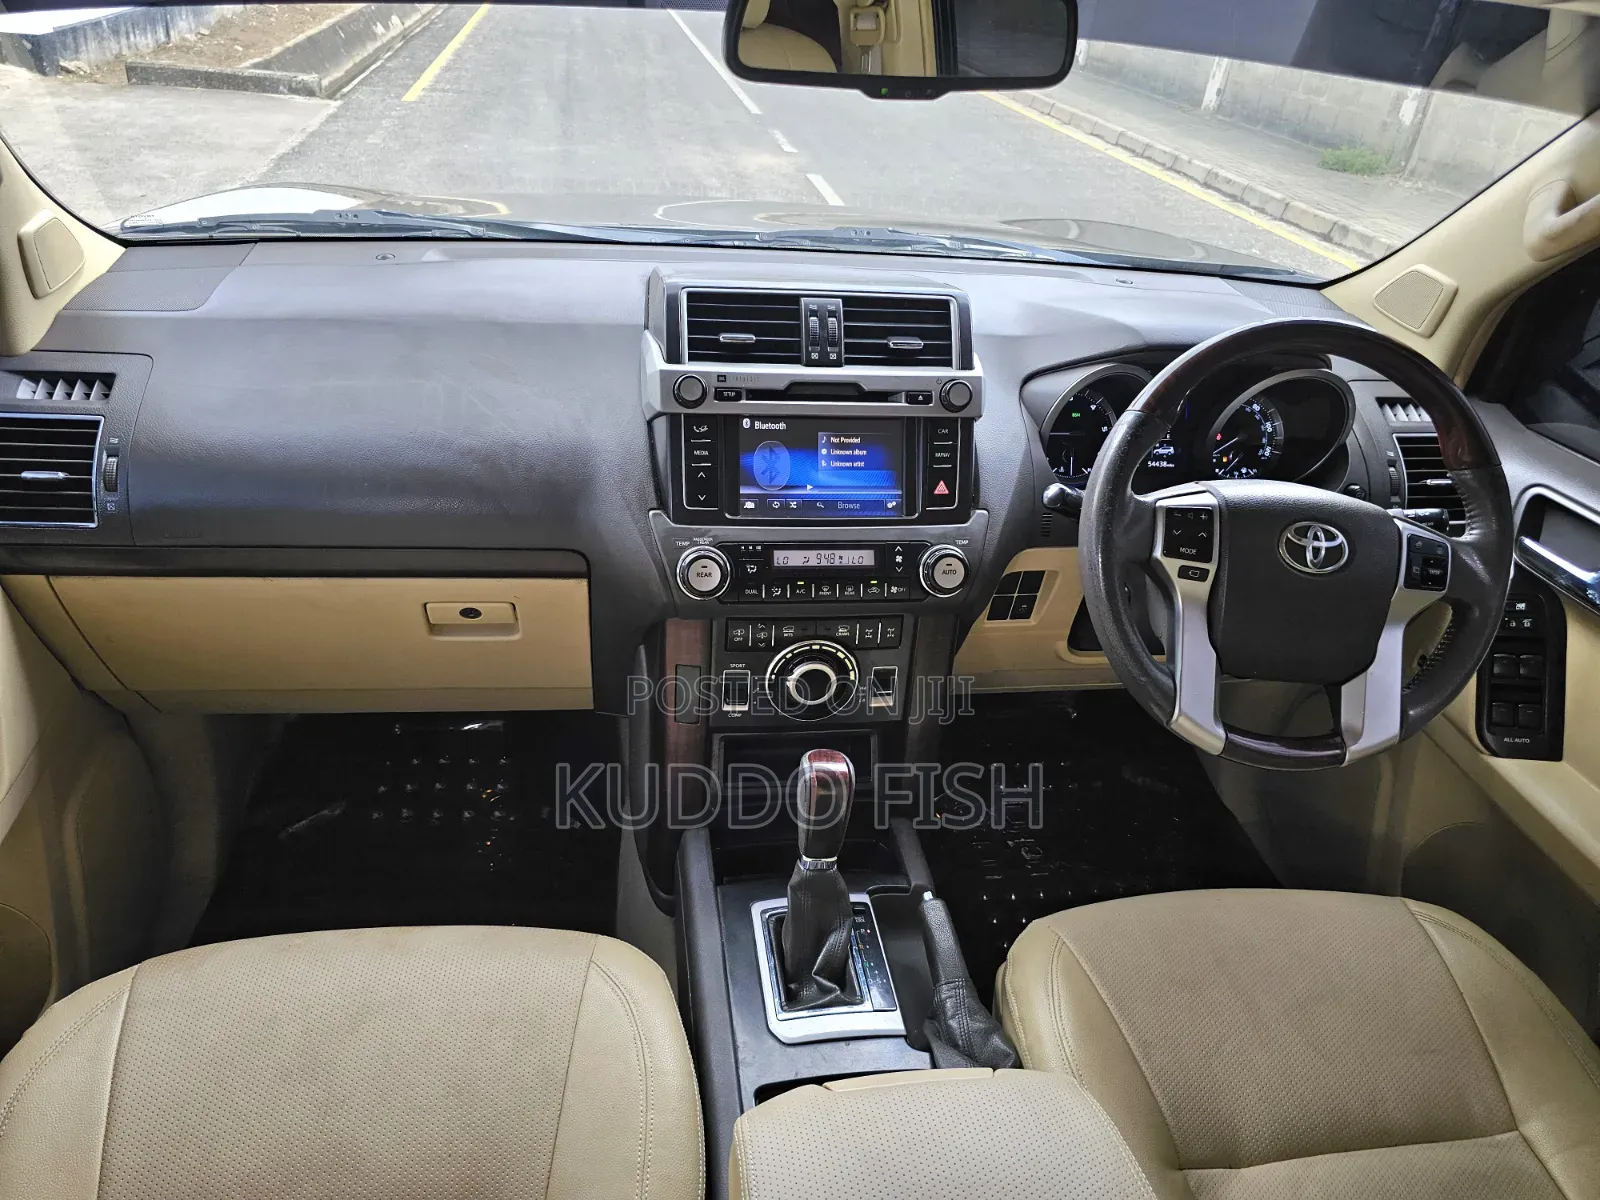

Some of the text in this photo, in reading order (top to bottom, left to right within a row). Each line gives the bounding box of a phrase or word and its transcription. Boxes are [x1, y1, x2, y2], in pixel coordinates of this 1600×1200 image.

[754, 420, 787, 430] Bluetooth
[1265, 421, 1273, 433] 100
[830, 436, 861, 444] Not Provided
[830, 448, 867, 456] Unknown album
[830, 460, 865, 468] Unknown artist
[837, 501, 861, 509] Browse
[1179, 546, 1197, 555] MODE
